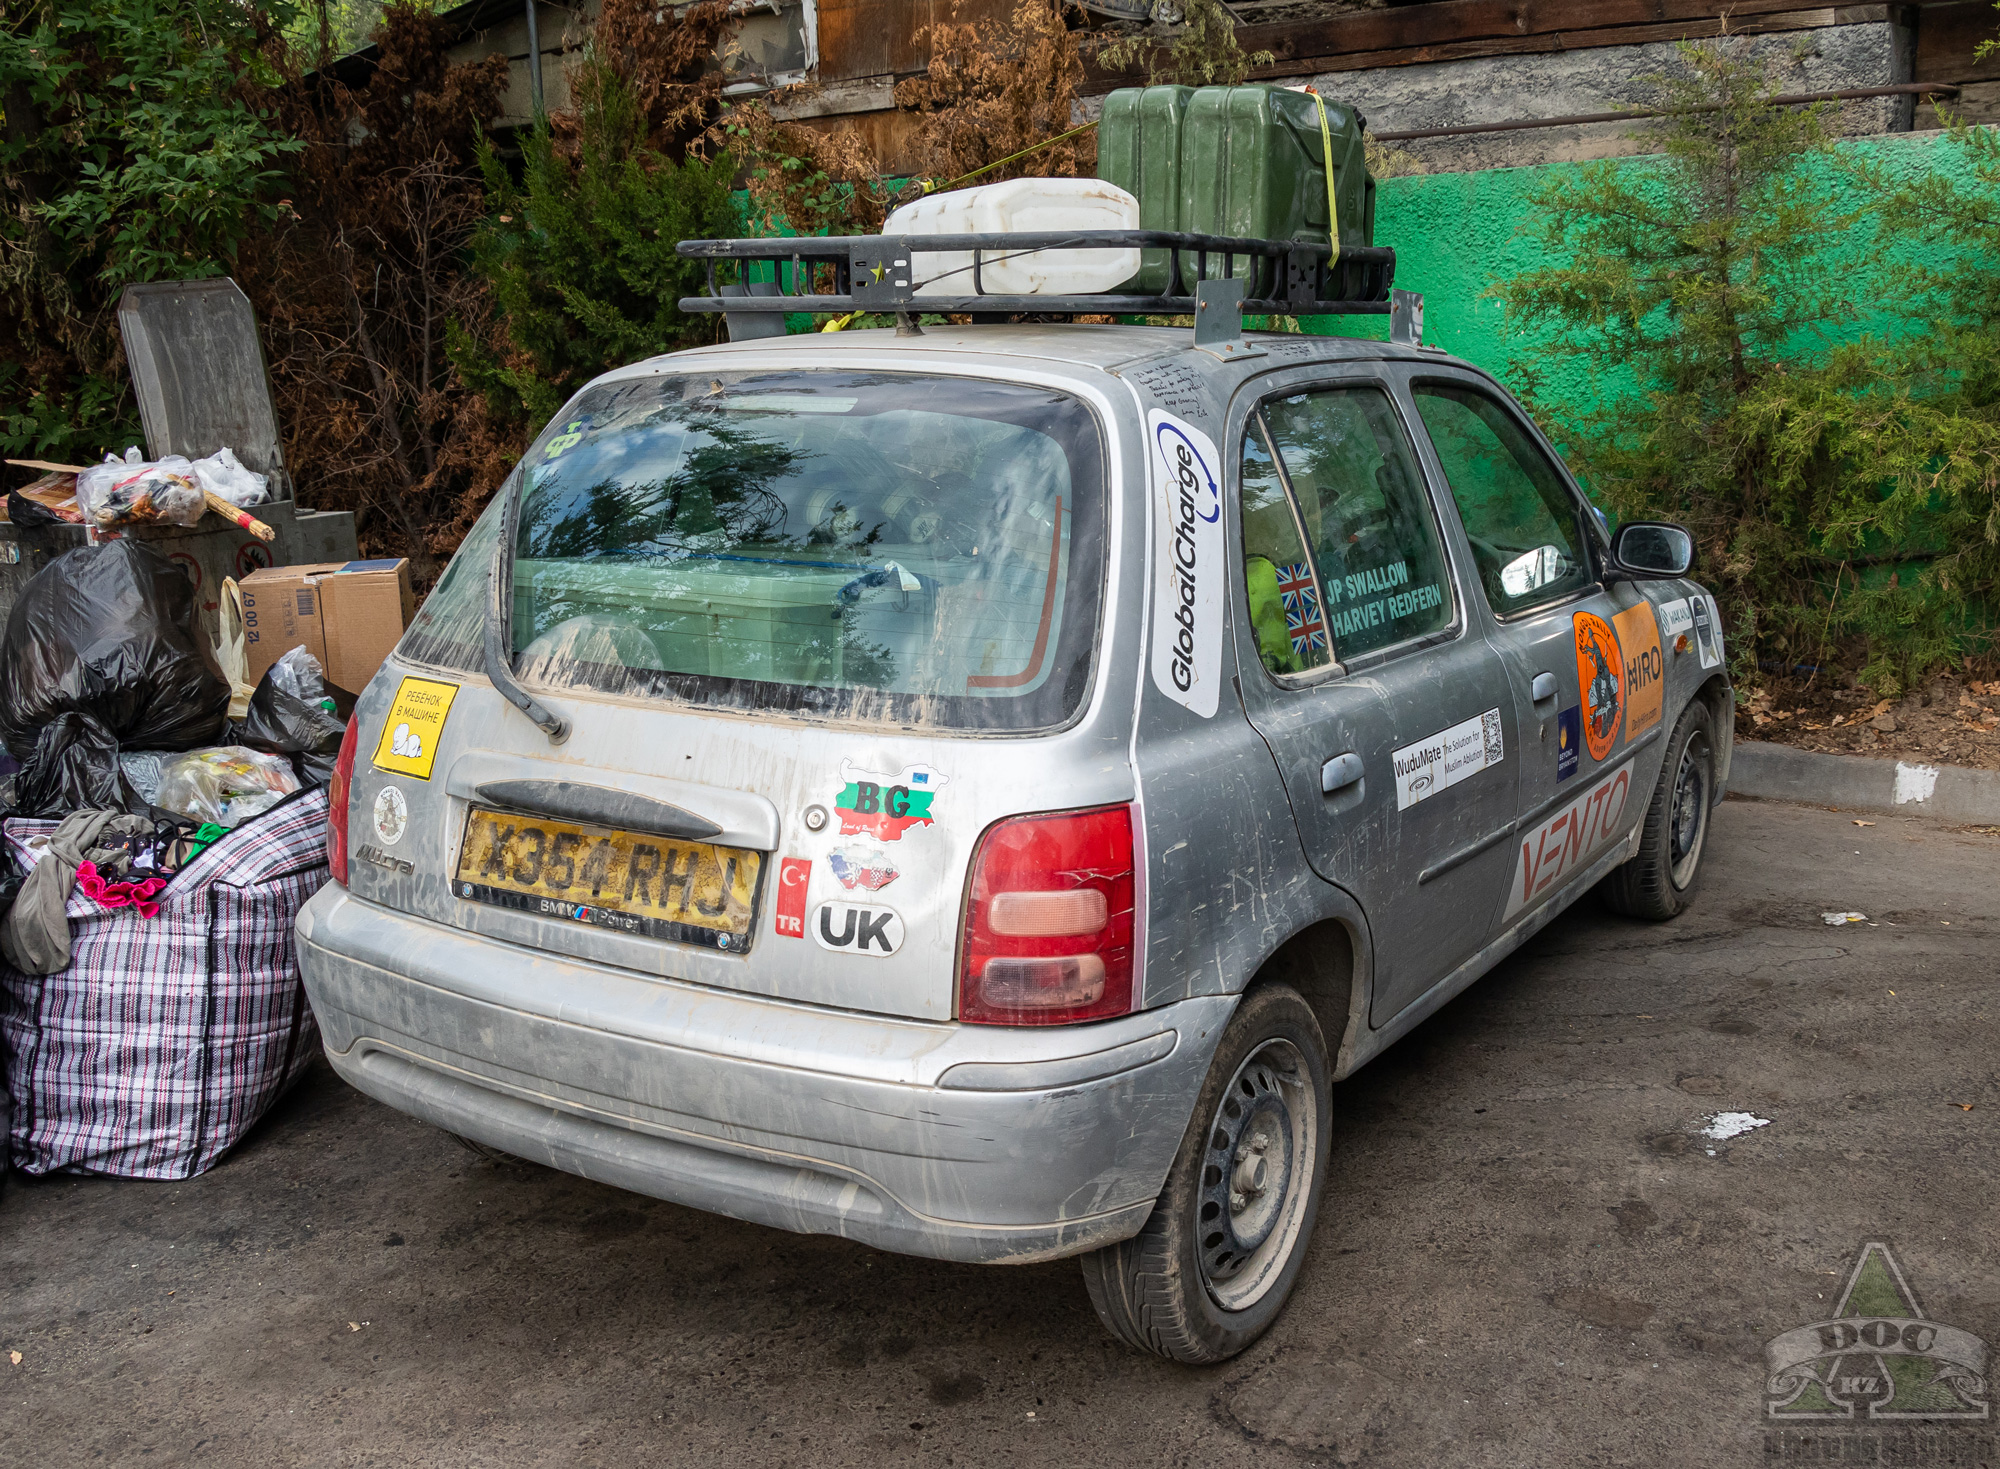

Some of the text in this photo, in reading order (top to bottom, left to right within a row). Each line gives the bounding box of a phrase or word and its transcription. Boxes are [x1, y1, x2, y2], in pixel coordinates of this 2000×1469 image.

[1171, 444, 1200, 692] GlobalCharge
[1327, 561, 1408, 605] JP SWALLOW
[243, 591, 260, 645] 12 00 67
[1331, 584, 1442, 638] HARVEY REDFERN
[1626, 645, 1661, 696] HIRO
[396, 705, 440, 724] В МАШИНЕ
[406, 690, 443, 707] РЕБЁНОК
[1394, 730, 1480, 778] WuduMate The Solution for
[1444, 749, 1483, 775] Muslim Ablution
[853, 781, 911, 819] BG
[1522, 769, 1629, 903] VENTO
[480, 821, 737, 917] X354 RHJ
[540, 899, 575, 917] BMW
[777, 914, 801, 932] TR
[820, 905, 894, 952] UK
